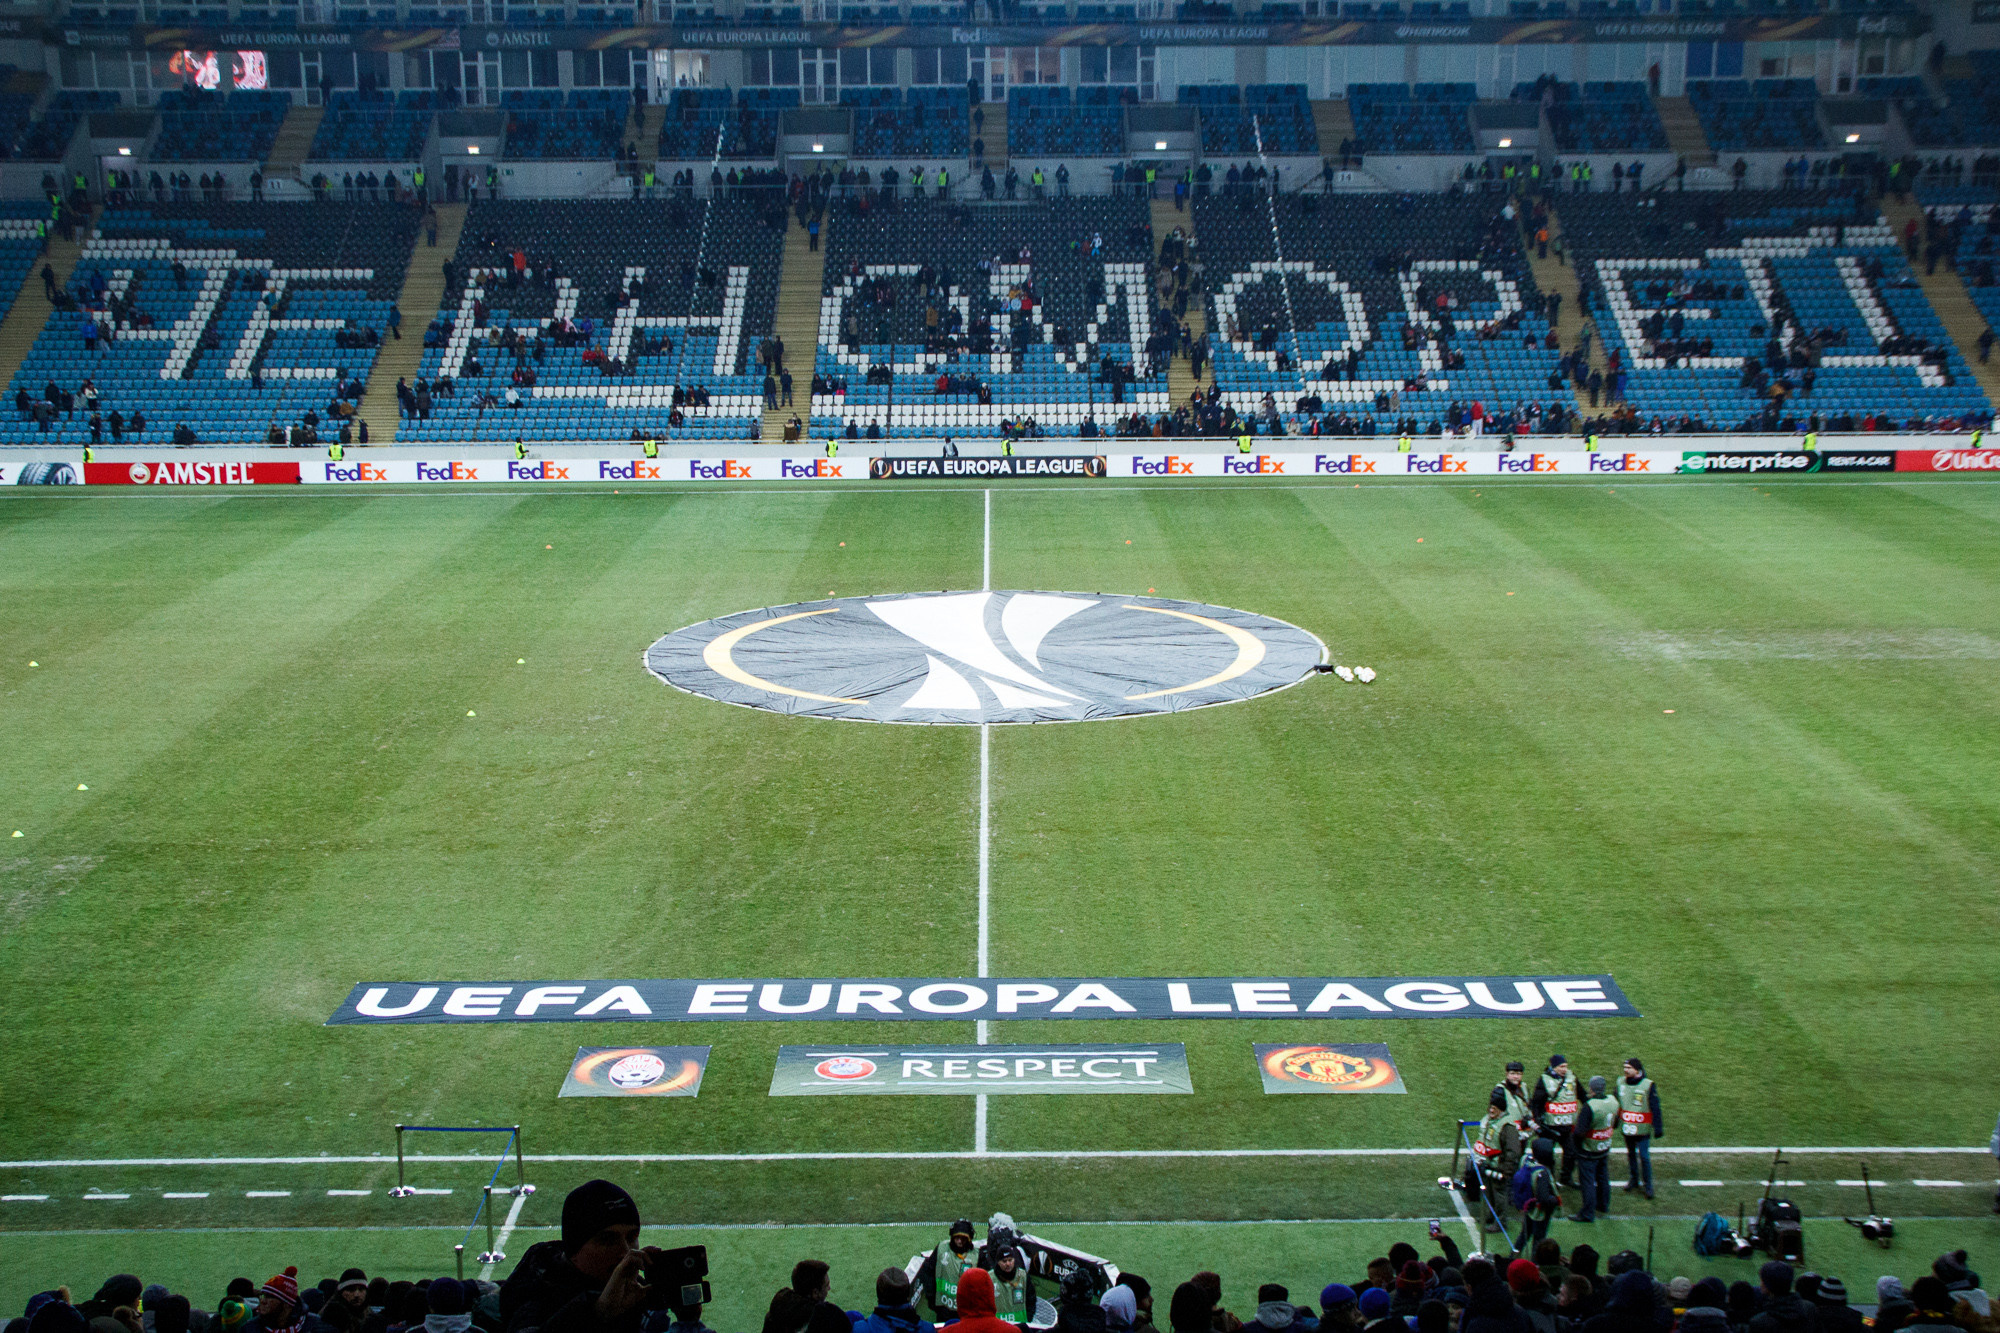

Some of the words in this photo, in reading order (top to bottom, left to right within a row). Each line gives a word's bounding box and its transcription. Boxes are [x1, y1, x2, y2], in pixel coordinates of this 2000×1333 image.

[220, 34, 252, 44] UEFA
[255, 34, 301, 44] EUROPA
[303, 34, 350, 44] LEAGUE
[502, 32, 551, 45] AMSTEL
[682, 31, 713, 43] UEFA
[716, 31, 761, 43] EUROPA
[764, 31, 811, 43] LEAGUE
[1140, 28, 1172, 39] UEFA
[1174, 28, 1220, 39] EUROPA
[1223, 27, 1270, 39] LEAGUE
[417, 462, 478, 480] FedEx
[508, 461, 570, 479] FedEx
[600, 461, 661, 479] FedEx
[691, 460, 752, 478] FedEx
[782, 460, 843, 478] FedEx
[892, 461, 939, 475] UEFA
[943, 460, 1012, 475] EUROPA
[1015, 459, 1084, 474] LEAGUE
[1132, 456, 1194, 474] FedEx
[1224, 456, 1285, 474] FedEx
[1315, 455, 1377, 473] FedEx
[1407, 455, 1468, 473] FedEx
[1499, 454, 1560, 472] FedEx
[1590, 454, 1651, 472] FedEx
[1686, 453, 1809, 472] enterprise
[153, 463, 255, 484] AMSTEL
[326, 463, 387, 481] FedEx
[355, 985, 653, 1017] UEFA
[687, 983, 1138, 1014] EUROPA
[1167, 980, 1619, 1012] LEAGUE
[902, 1058, 1158, 1078] RESPECT
[944, 1282, 958, 1295] HB
